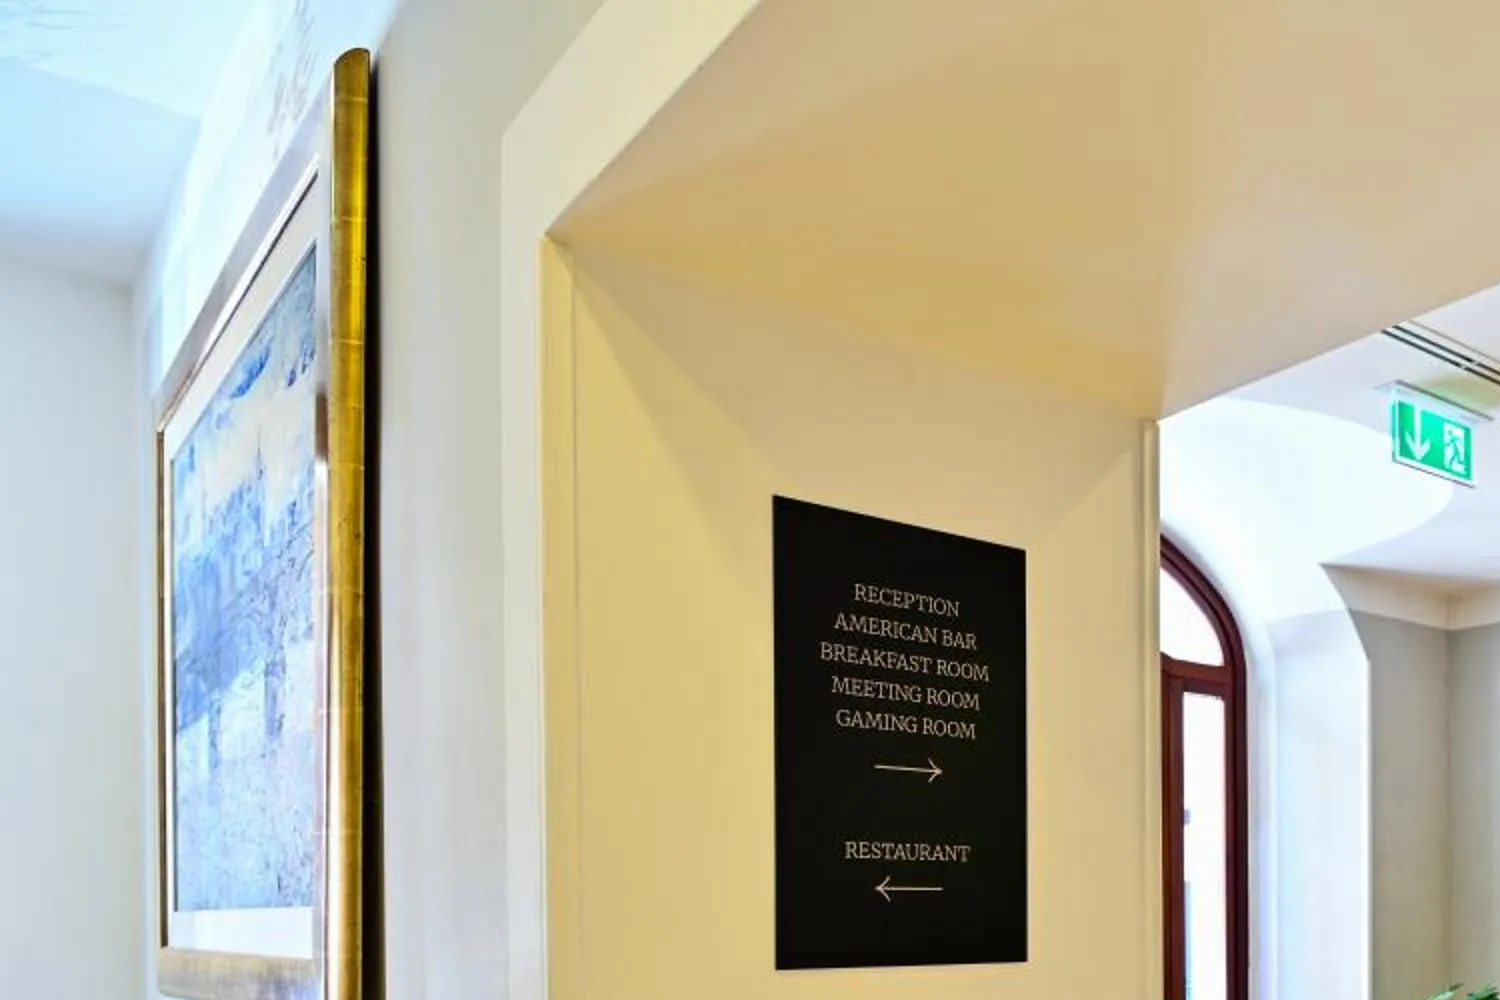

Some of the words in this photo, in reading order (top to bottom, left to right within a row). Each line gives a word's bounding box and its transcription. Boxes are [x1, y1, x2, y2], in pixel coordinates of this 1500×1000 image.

[854, 583, 960, 617] RECEPTION
[834, 613, 938, 644] AMERICAN
[941, 629, 977, 650] BAR
[820, 641, 933, 673] BREAKFAST
[936, 659, 990, 682] ROOM
[831, 675, 923, 703] MEETING
[926, 687, 980, 711] ROOM
[835, 709, 918, 734] GAMING
[922, 717, 977, 740] ROOM
[844, 841, 971, 862] RESTAURANT
